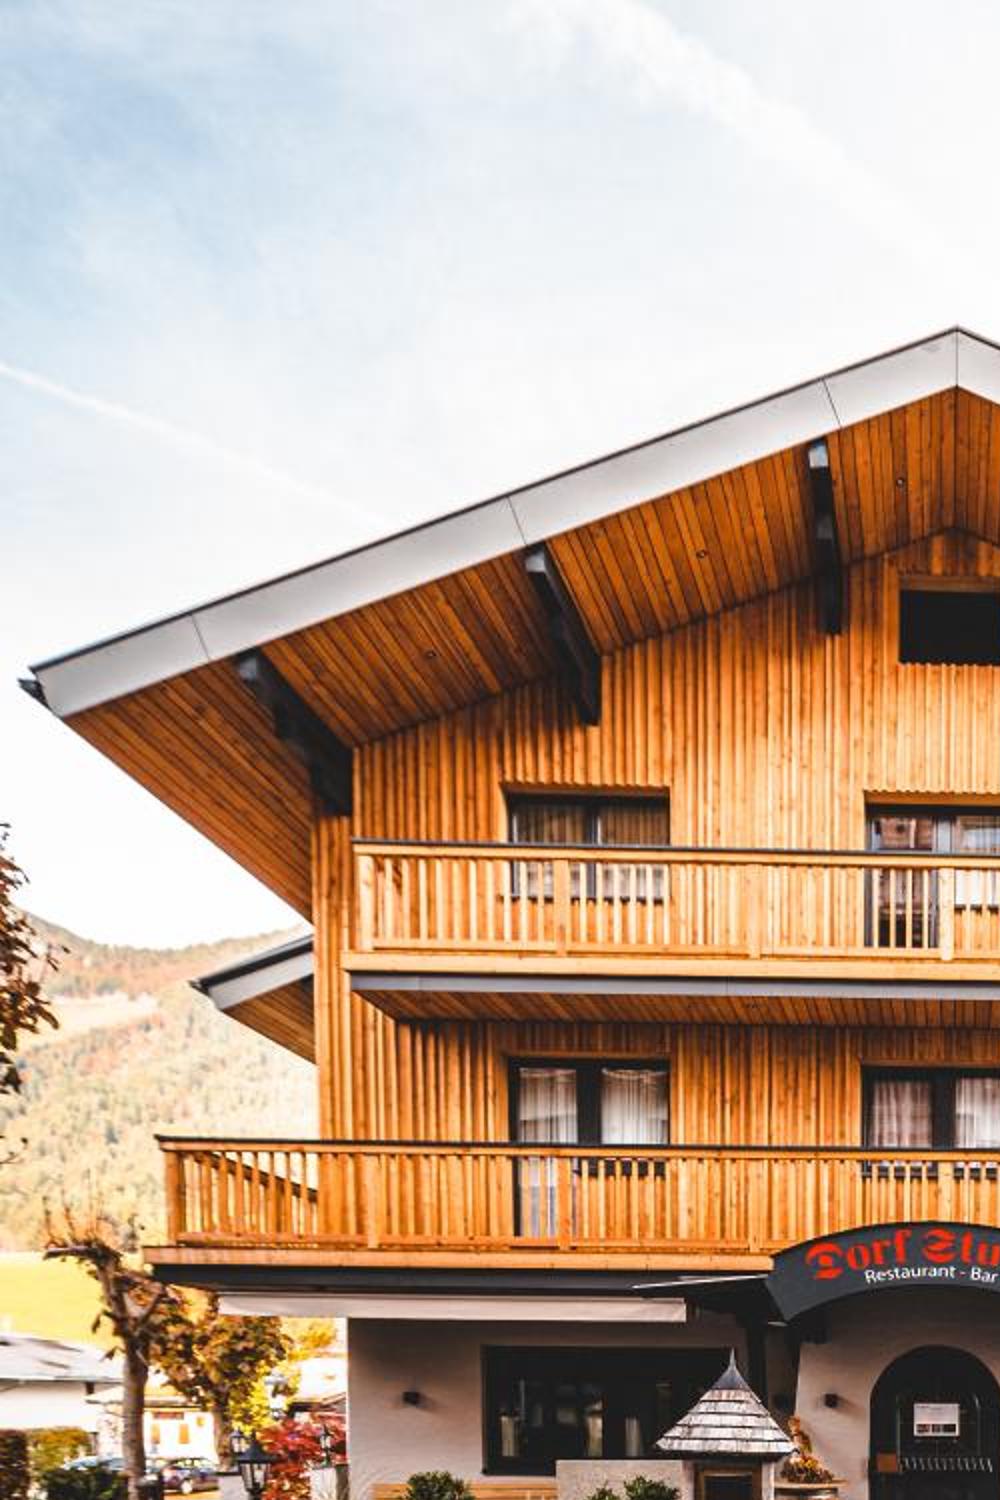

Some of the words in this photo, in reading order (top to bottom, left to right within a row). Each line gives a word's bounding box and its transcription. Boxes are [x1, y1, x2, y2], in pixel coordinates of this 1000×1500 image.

[805, 1229, 912, 1280] Dorf
[864, 1265, 956, 1284] Restaurant
[970, 1267, 999, 1284] Bar
